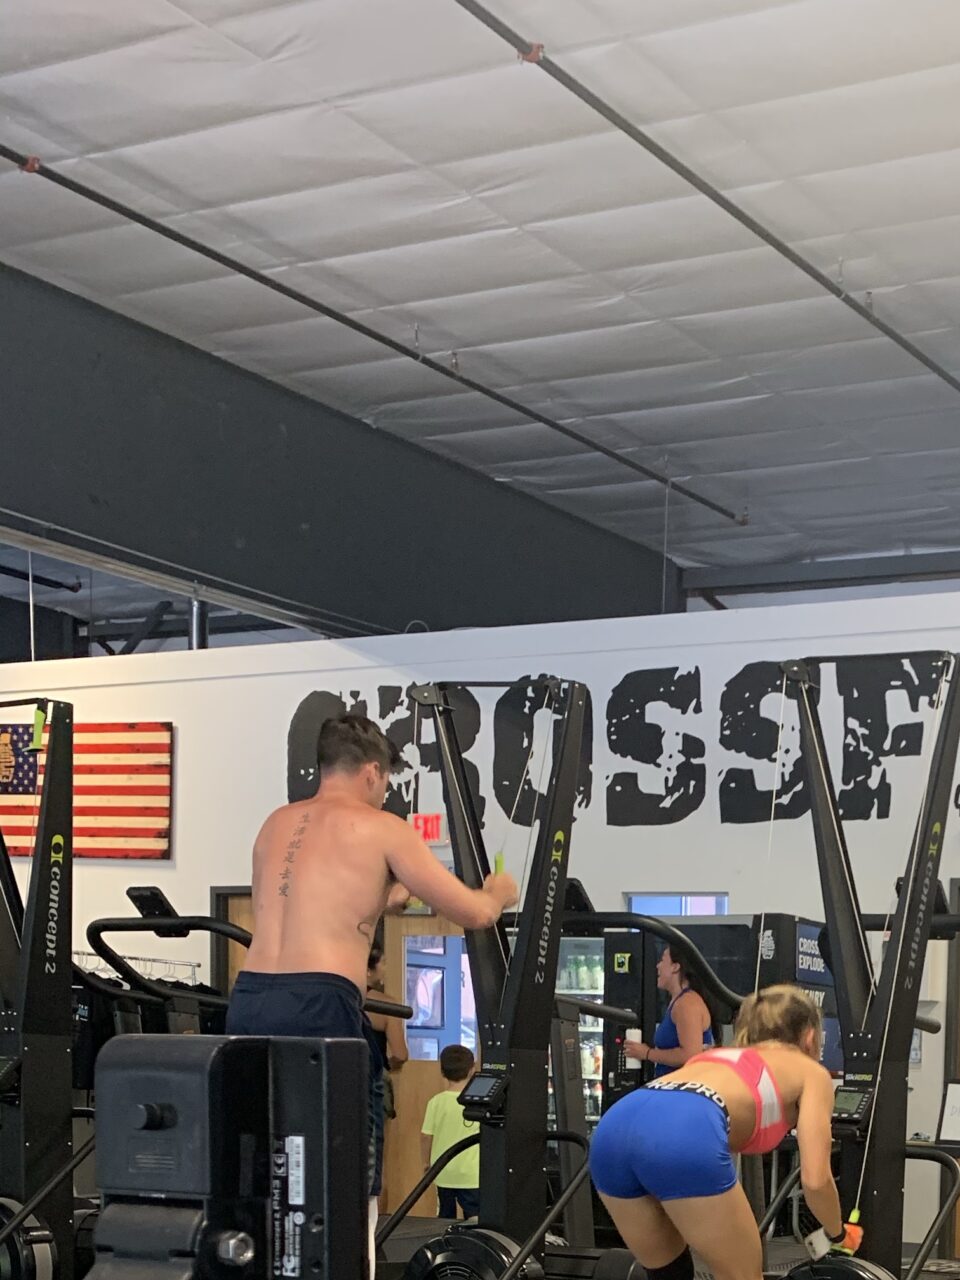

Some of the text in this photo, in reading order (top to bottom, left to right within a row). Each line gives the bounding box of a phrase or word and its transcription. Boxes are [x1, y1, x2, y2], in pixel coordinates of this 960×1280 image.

[45, 866, 62, 975] concept 2
[534, 865, 559, 984] concept 2
